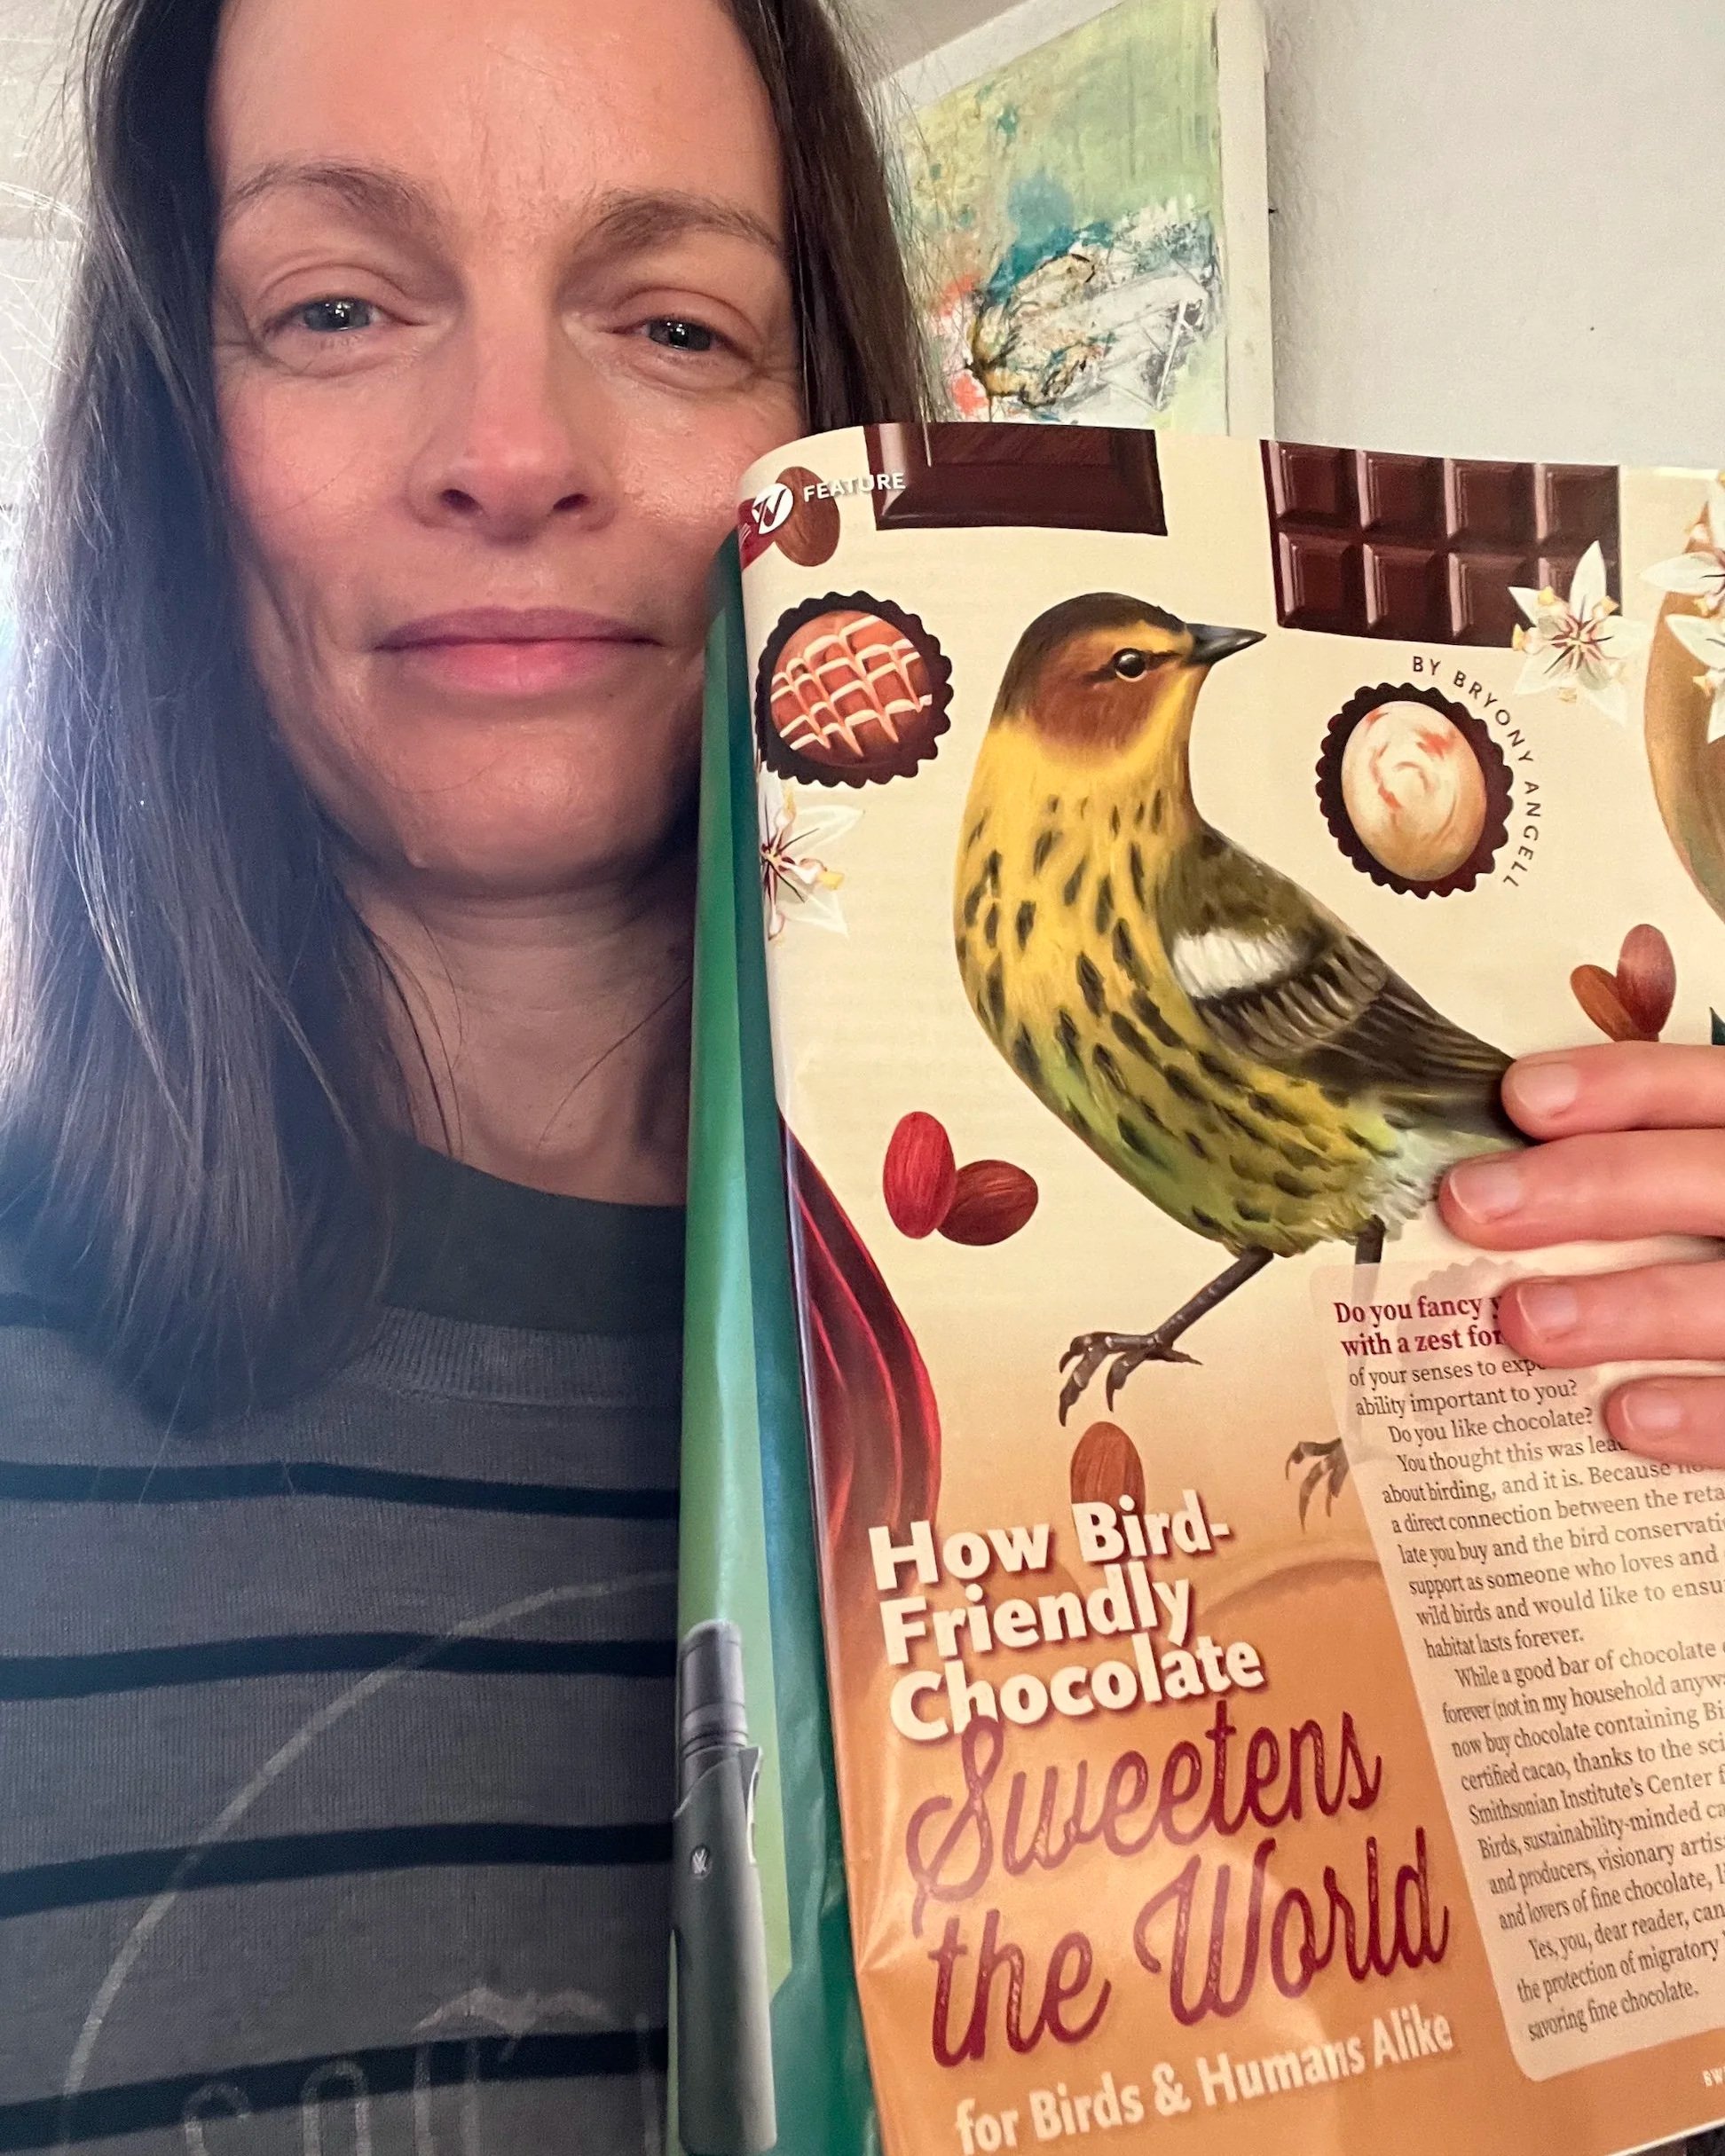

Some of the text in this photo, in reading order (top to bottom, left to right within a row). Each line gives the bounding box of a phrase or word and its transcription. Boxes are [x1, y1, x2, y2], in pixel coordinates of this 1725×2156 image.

[803, 472, 906, 502] FEATURE
[1413, 656, 1541, 887] BY BRYONY ANGELL
[1334, 1302, 1366, 1323] Do
[1369, 1302, 1413, 1327] you
[1417, 1295, 1482, 1320] fancy
[1340, 1333, 1392, 1357] with
[1398, 1336, 1410, 1354] a
[1415, 1329, 1463, 1352] zest
[1350, 1367, 1366, 1387] of
[1369, 1369, 1407, 1391] your
[1412, 1364, 1473, 1382] senses
[1477, 1360, 1497, 1376] to
[1356, 1379, 1578, 1419] ability important to you?
[1388, 1406, 1593, 1447] Do you like chocolate?
[1397, 1454, 1427, 1472] You
[1430, 1447, 1503, 1473] thought
[1508, 1441, 1543, 1463] this
[1548, 1441, 1585, 1458] was
[1382, 1483, 1426, 1504] about
[1427, 1479, 1497, 1502] birding,
[1501, 1471, 1539, 1494] and
[1543, 1471, 1558, 1490] it
[1562, 1469, 1583, 1487] is.
[1587, 1463, 1671, 1485] Because
[1391, 1519, 1402, 1533] a
[1404, 1512, 1446, 1532] direct
[1449, 1504, 1552, 1530] connection
[1555, 1497, 1640, 1519] between
[1644, 1489, 1678, 1509] the
[868, 1489, 1230, 1591] How Bird-
[1397, 1544, 1428, 1564] late
[1430, 1546, 1456, 1568] you
[1457, 1540, 1488, 1565] buy
[1492, 1535, 1528, 1557] and
[1532, 1532, 1564, 1552] the
[1567, 1525, 1610, 1548] bird
[1408, 1543, 1719, 1600] support as someone who loves and
[878, 1563, 1192, 1666] Friendly
[1416, 1604, 1451, 1625] wild
[1451, 1601, 1493, 1624] birds
[1496, 1597, 1530, 1620] and
[1532, 1589, 1595, 1614] would
[1598, 1585, 1638, 1608] like
[1644, 1585, 1666, 1601] to
[1423, 1628, 1584, 1658] habitat lasts forever.
[1454, 1641, 1716, 1688] While a good bar of chocolate
[889, 1636, 1266, 1741] Chocolate
[1442, 1702, 1491, 1723] forever
[1493, 1698, 1524, 1721] (not
[1523, 1693, 1540, 1713] in
[1543, 1694, 1567, 1715] my
[1569, 1675, 1666, 1707] household
[1452, 1739, 1482, 1758] now
[1482, 1731, 1510, 1758] buy
[1514, 1721, 1591, 1748] chocolate
[1595, 1707, 1700, 1736] containing
[1461, 1762, 1521, 1791] certified
[1522, 1761, 1571, 1781] cacao,
[1573, 1746, 1634, 1773] thanks
[1637, 1746, 1656, 1763] to
[1661, 1738, 1693, 1759] the
[905, 1700, 1382, 1937] Sweetens
[1469, 1792, 1560, 1826] Smithsonian
[1559, 1776, 1644, 1809] Institute's
[1646, 1772, 1713, 1794] Center
[1477, 1833, 1523, 1859] Birds,
[1523, 1800, 1702, 1853] sustainability-minded
[1490, 1868, 1516, 1894] and
[1518, 1860, 1597, 1896] producers,
[1597, 1845, 1674, 1871] visionary
[1499, 1901, 1526, 1930] and
[1525, 1900, 1570, 1924] lovers
[1572, 1888, 1588, 1913] of
[1591, 1885, 1621, 1909] fine
[1625, 1870, 1713, 1901] chocolate,
[929, 1826, 1449, 2068] the World
[1528, 1938, 1559, 1961] Yes,
[1559, 1932, 1593, 1961] you,
[1595, 1922, 1629, 1945] dear
[1632, 1908, 1690, 1937] reader,
[1516, 1938, 1719, 2003] the protection of migratory
[1528, 1980, 1699, 2042] savoring fine chocolate.
[956, 2004, 1453, 2156] for Birds & Humans Alike
